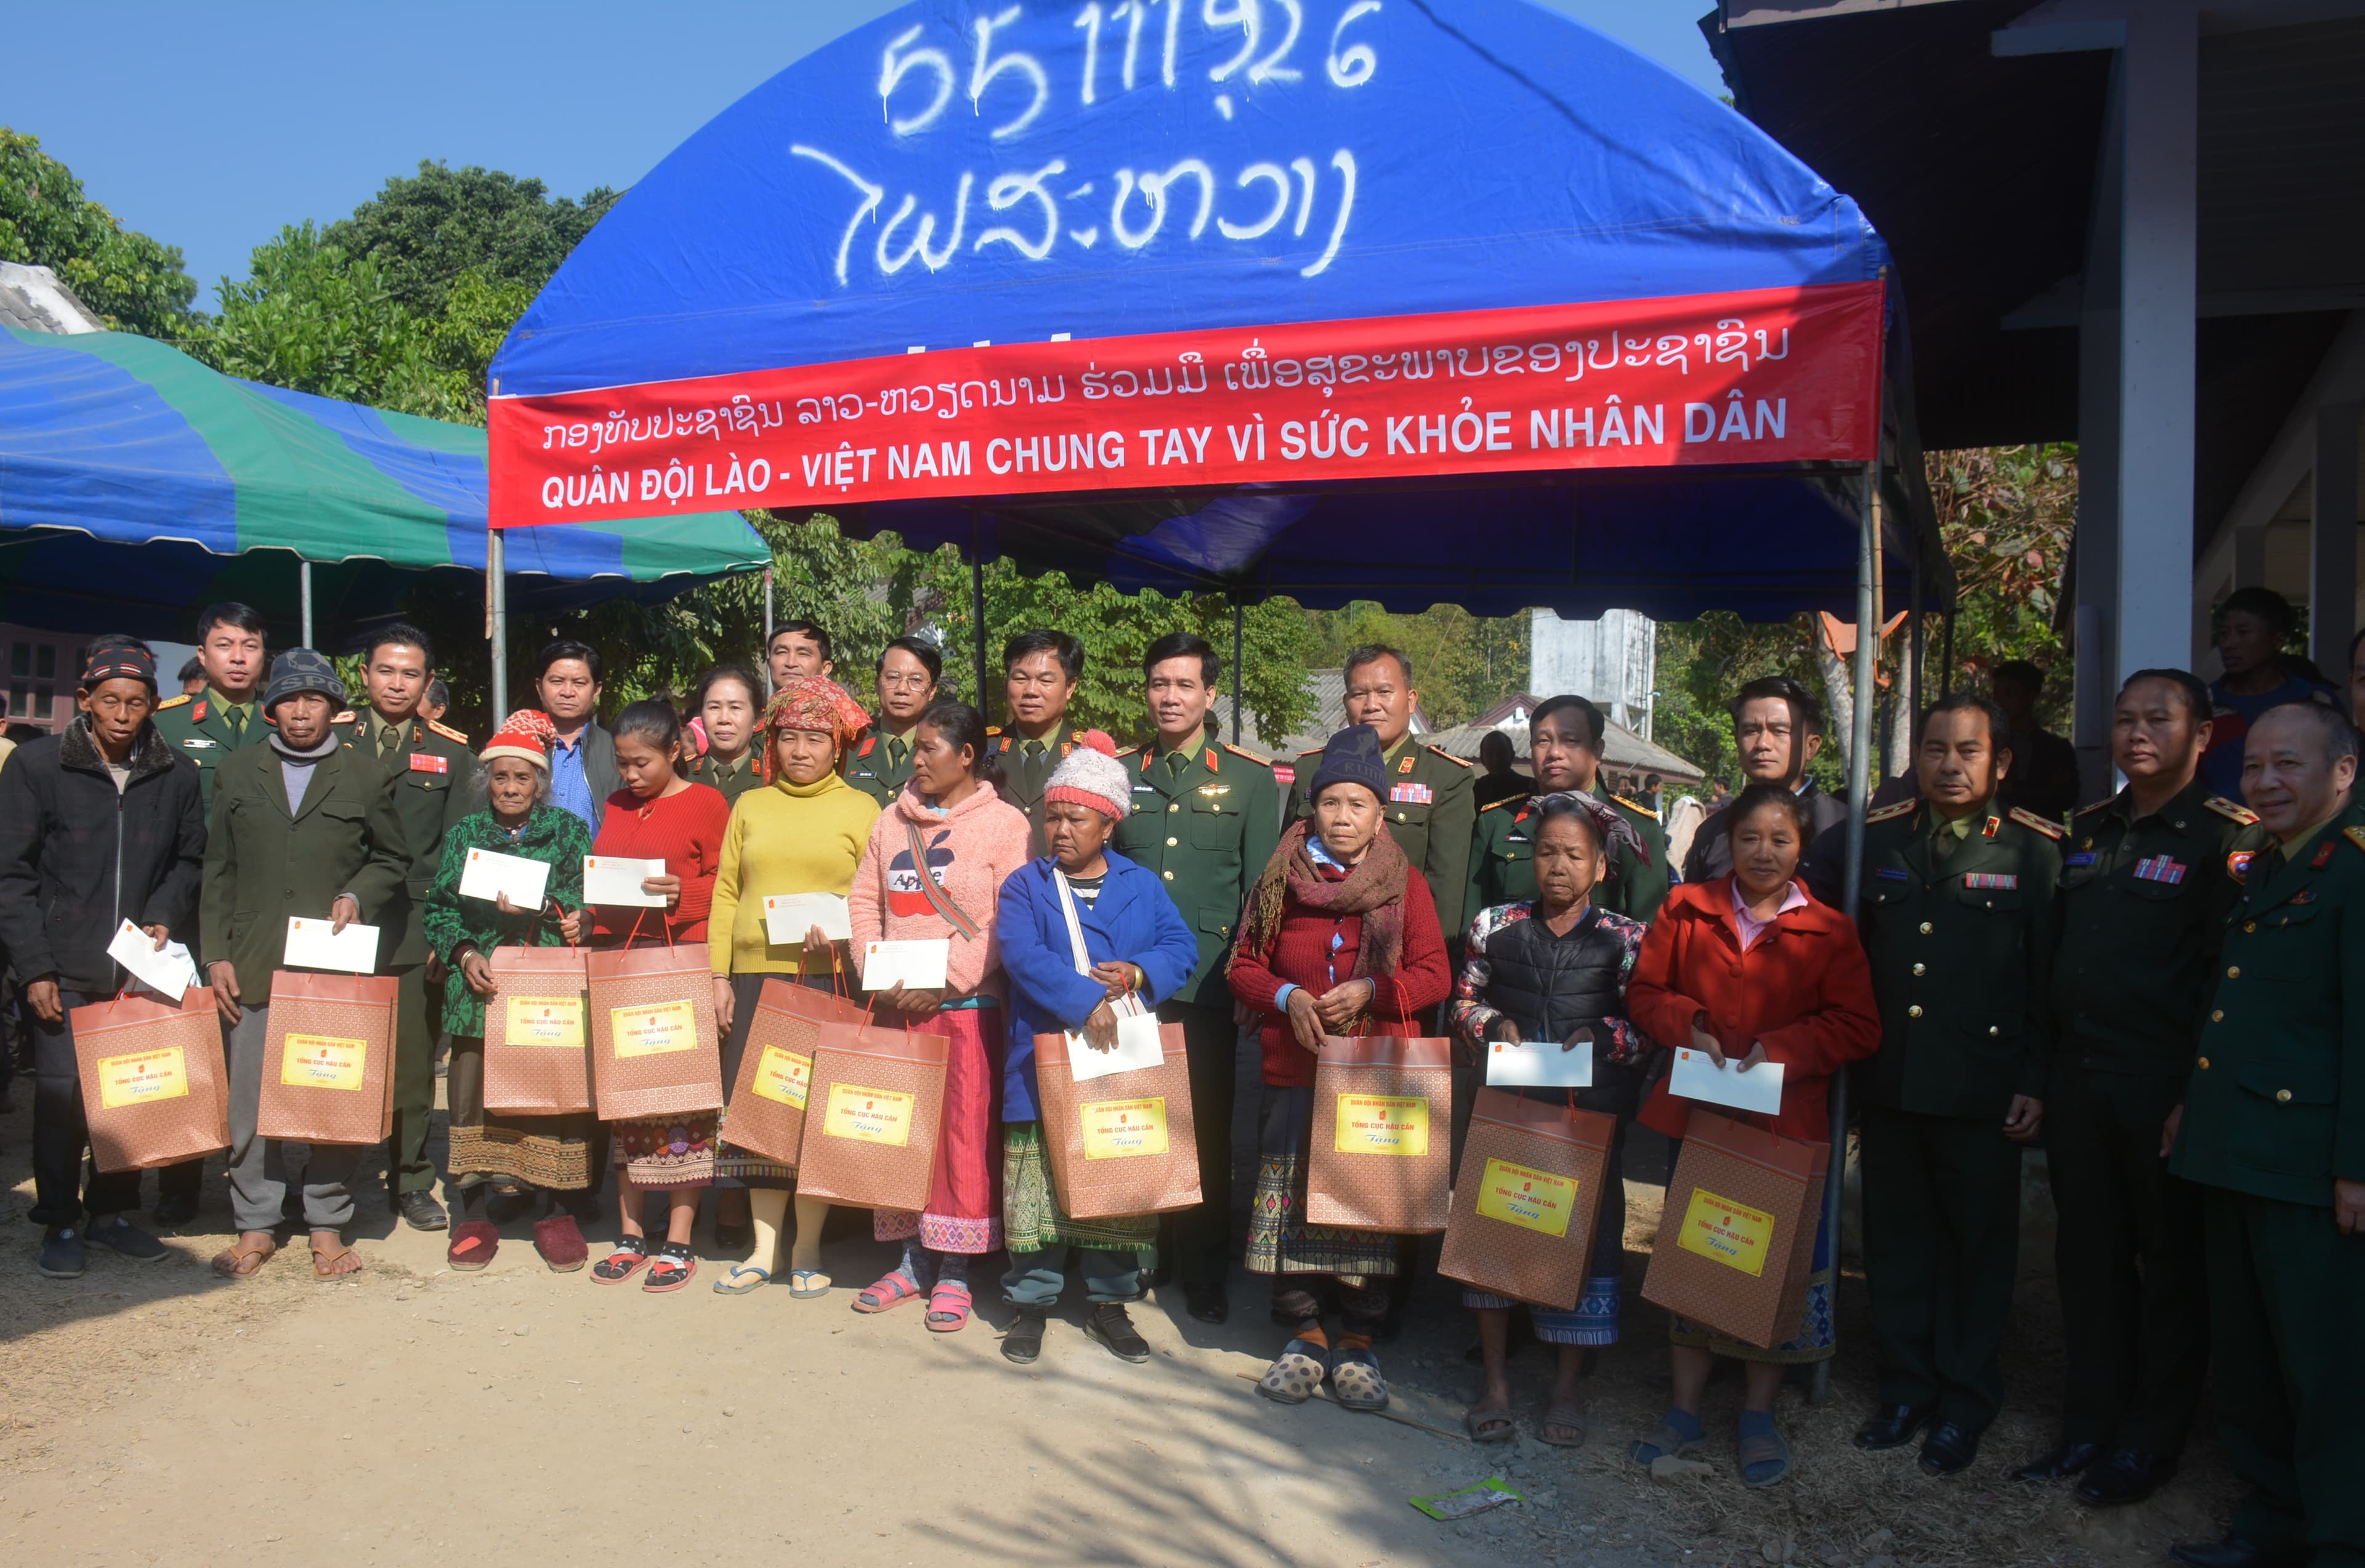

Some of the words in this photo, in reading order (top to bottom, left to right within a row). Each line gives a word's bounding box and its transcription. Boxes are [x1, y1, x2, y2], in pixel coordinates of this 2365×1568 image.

[541, 464, 629, 508] QUÂN
[641, 458, 693, 505] ĐỘI
[705, 453, 770, 495] LÀO
[801, 442, 876, 492] VIỆT
[888, 440, 971, 480] NAM
[986, 430, 1125, 475] CHUNG
[1139, 426, 1212, 466] TAY
[1226, 413, 1265, 461] VÌ
[1280, 409, 1368, 461] SỨC
[1386, 397, 1512, 455] KHỎE
[1530, 394, 1664, 449] NHÂN
[1684, 389, 1787, 443] DÂN
